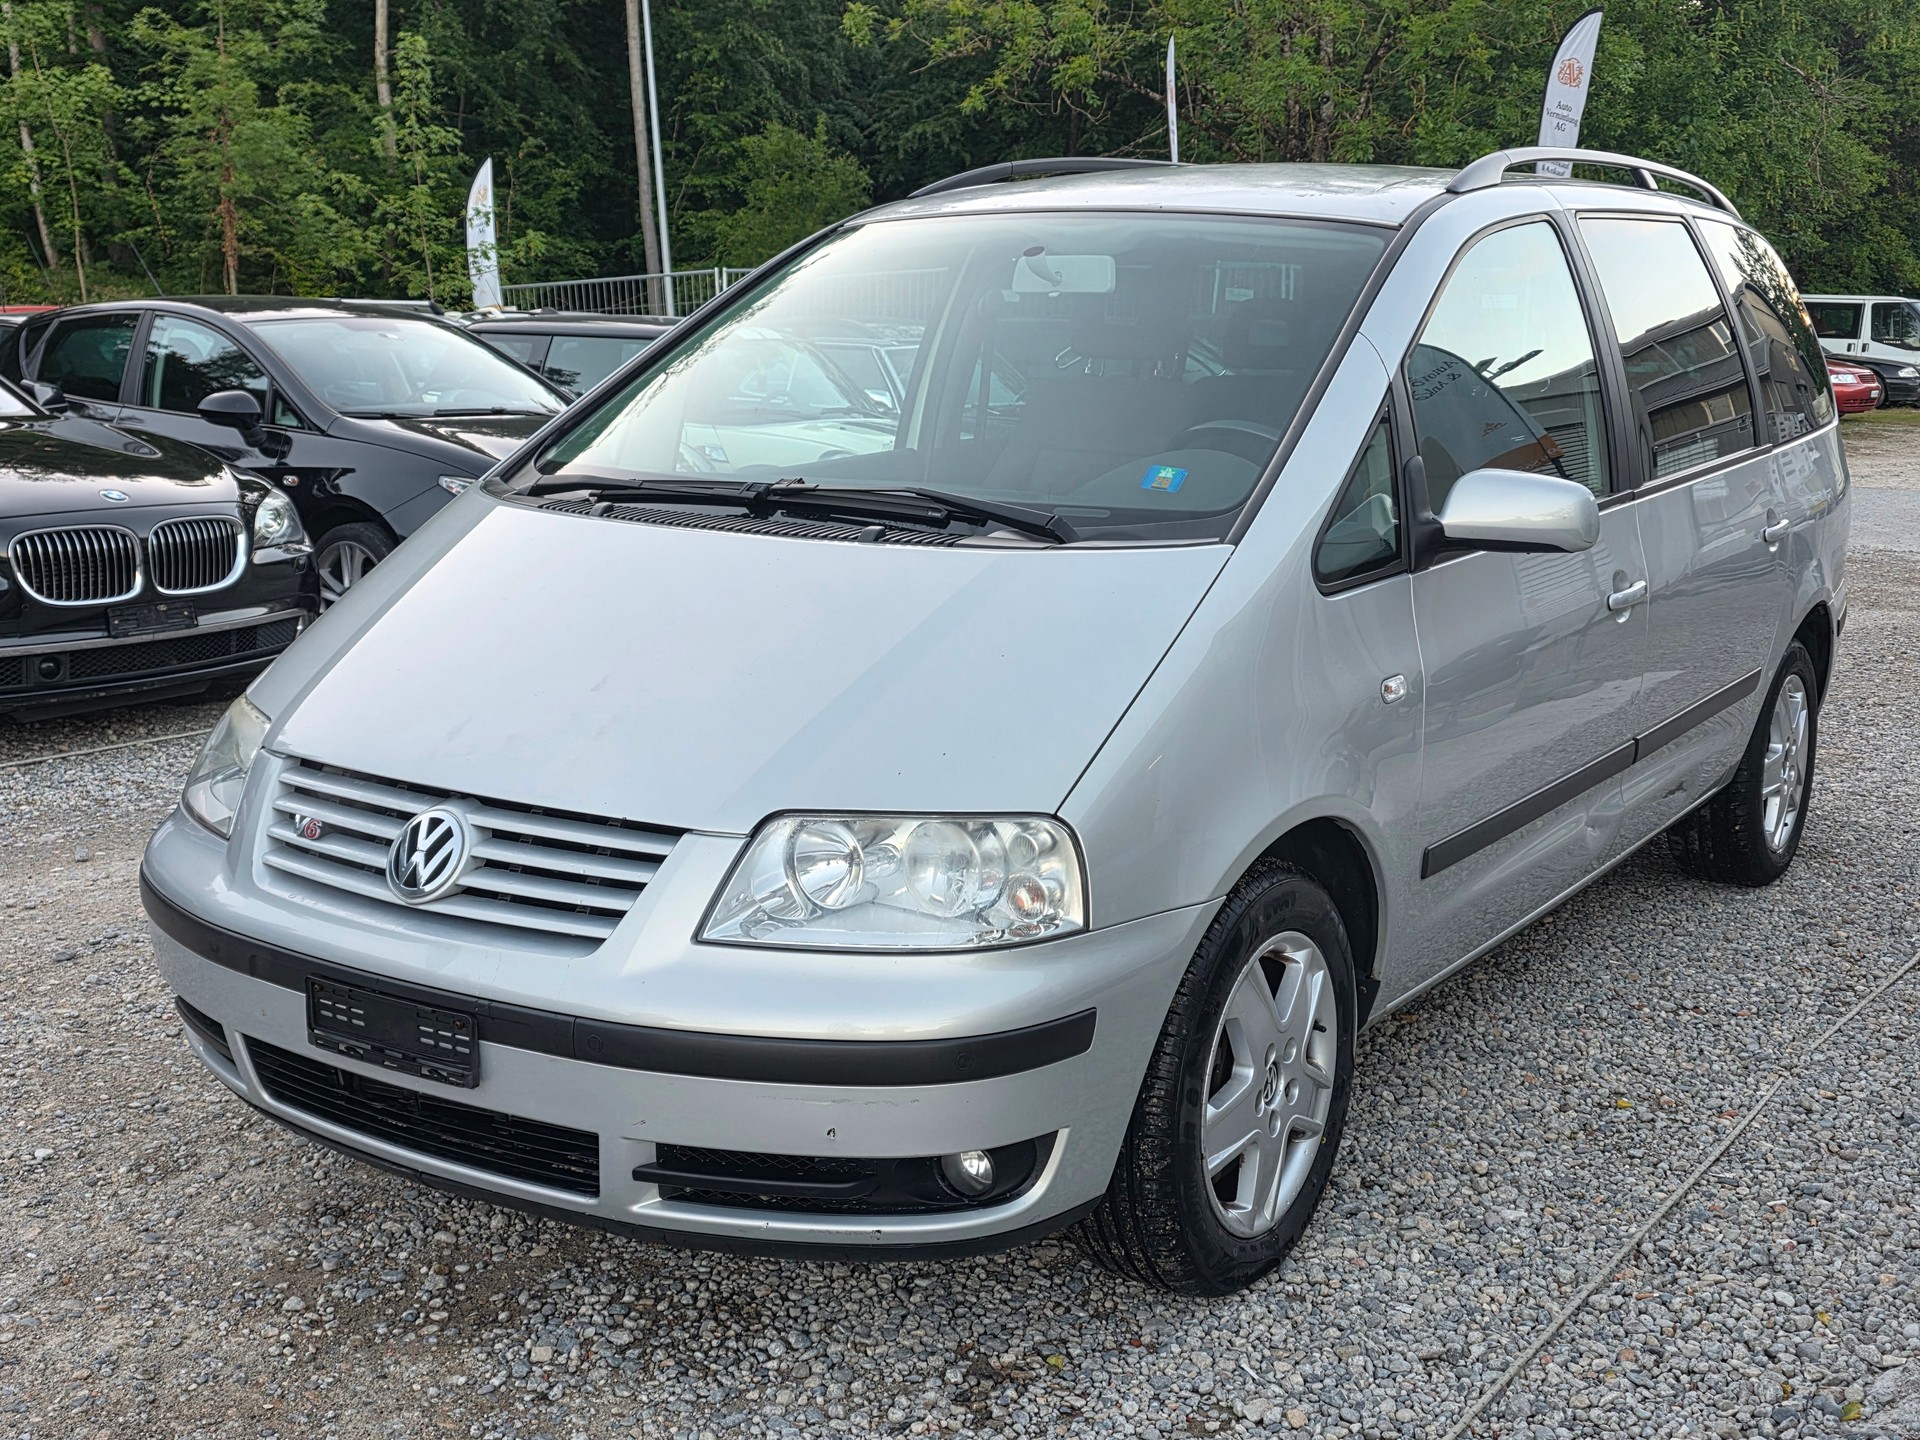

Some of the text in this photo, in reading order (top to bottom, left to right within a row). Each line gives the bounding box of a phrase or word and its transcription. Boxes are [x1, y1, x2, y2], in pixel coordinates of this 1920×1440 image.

[1556, 100, 1573, 113] Auto
[1554, 121, 1567, 132] AG
[294, 813, 323, 840] V6
[391, 809, 464, 897] VW
